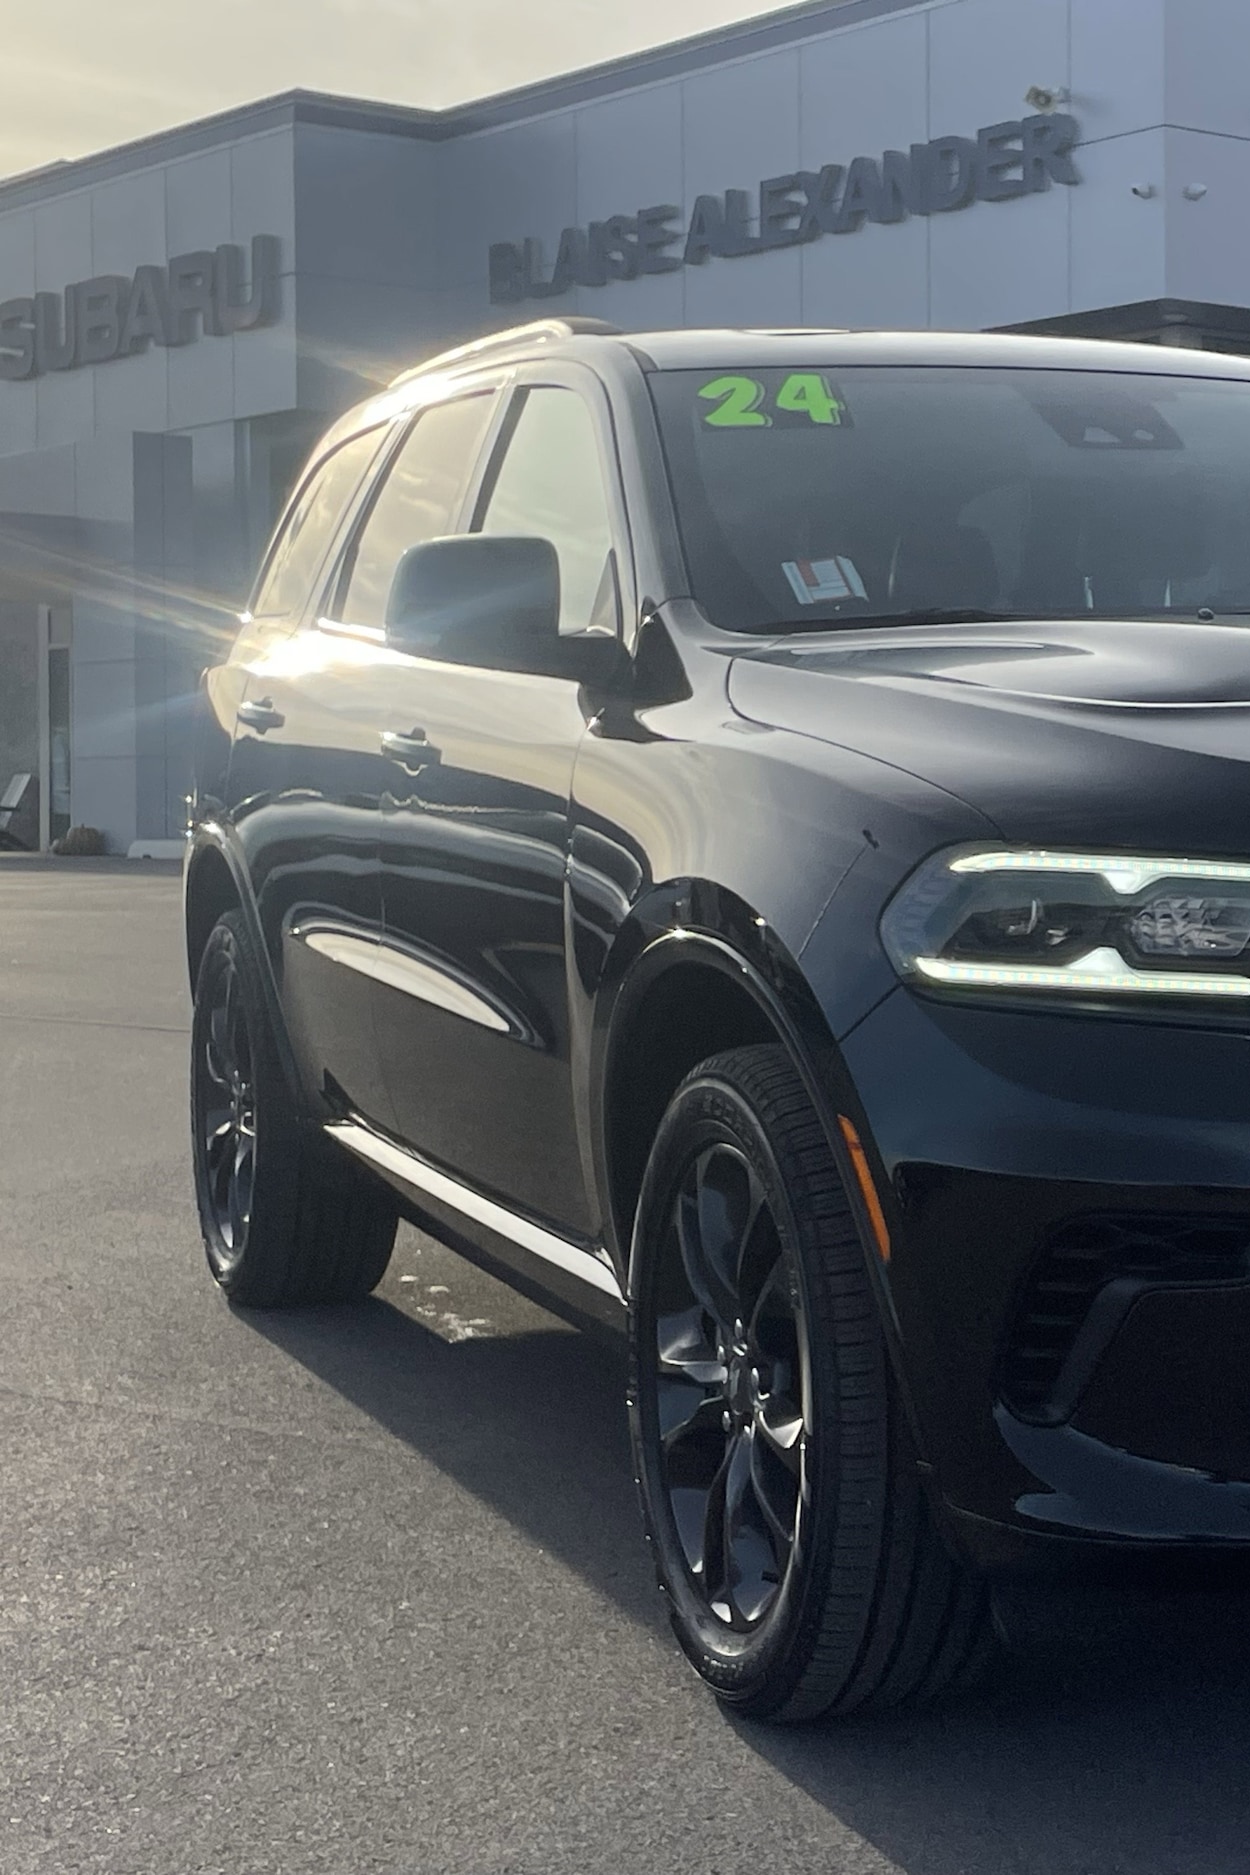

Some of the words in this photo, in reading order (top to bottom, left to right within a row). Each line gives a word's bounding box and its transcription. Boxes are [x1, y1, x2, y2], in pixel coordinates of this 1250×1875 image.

[489, 204, 684, 304] BLAISE
[683, 113, 1081, 264] ALEXANDER
[0, 234, 282, 381] SUBARU
[697, 373, 846, 428] 24
